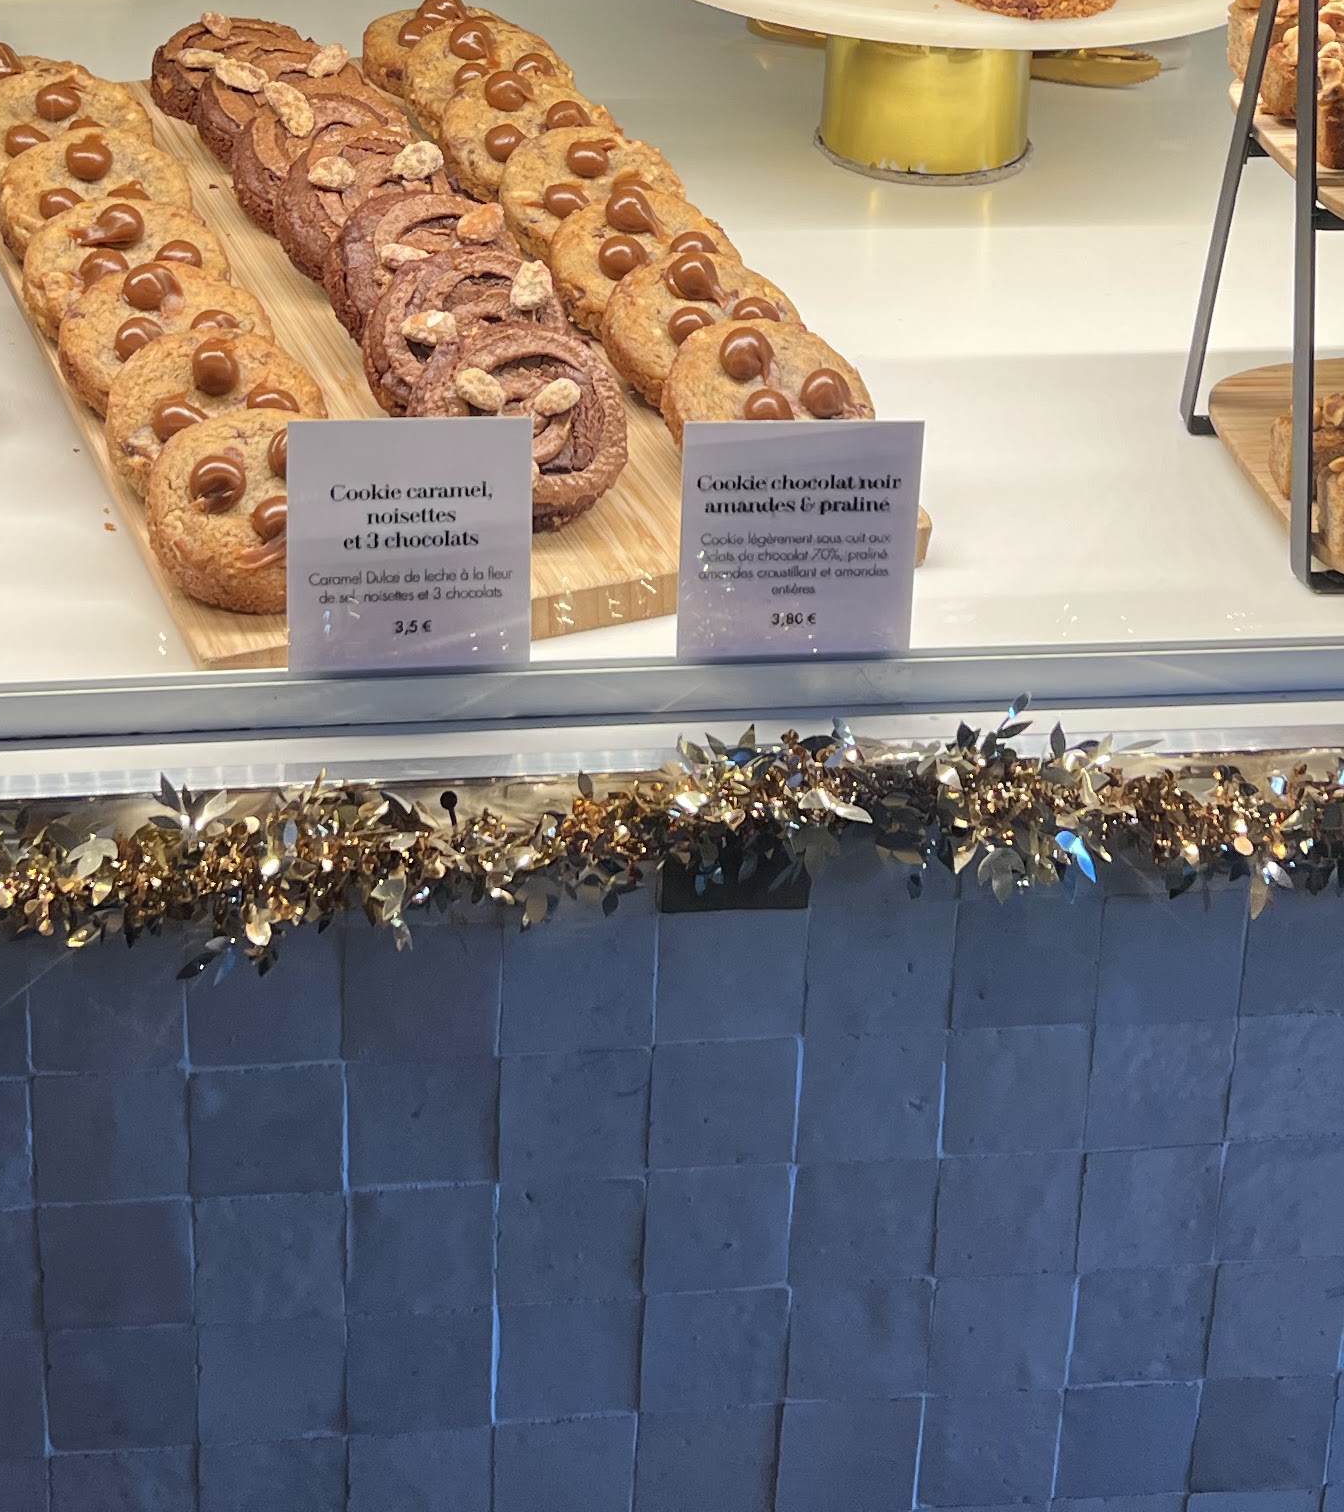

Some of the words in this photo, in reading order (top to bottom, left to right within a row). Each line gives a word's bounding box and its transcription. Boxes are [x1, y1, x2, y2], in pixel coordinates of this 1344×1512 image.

[330, 484, 401, 502] Cookie
[407, 481, 493, 500] caramel,
[697, 474, 767, 492] Cookie
[771, 474, 855, 490] chocolat
[859, 473, 902, 490] noir
[705, 496, 795, 514] amandes
[800, 496, 815, 513] &
[819, 494, 890, 516] praliné
[367, 508, 456, 526] noisettes
[344, 535, 361, 550] et
[367, 532, 379, 549] 3
[385, 530, 479, 548] chocolats
[701, 532, 744, 547] Cookie
[747, 532, 812, 548] légèrement
[816, 534, 841, 544] sous
[845, 532, 865, 544] cuit
[869, 534, 891, 543] aux
[706, 550, 735, 563] clats
[738, 549, 754, 562] de
[758, 549, 809, 562] chocolat
[847, 549, 888, 563] praliné
[309, 570, 362, 586] Caramel
[367, 569, 400, 584] Dulce
[404, 569, 421, 583] de
[425, 568, 456, 582] leche
[460, 567, 469, 581] à
[473, 566, 484, 580] la
[488, 565, 513, 580] fleur
[699, 567, 753, 580] amandes
[757, 565, 817, 579] croustillant
[820, 567, 831, 577] et
[835, 564, 888, 577] amandes
[319, 589, 335, 604] de
[364, 588, 414, 603] noisettes
[418, 588, 429, 601] et
[433, 587, 442, 600] 3
[446, 584, 502, 599] chocolats
[771, 584, 816, 595] entières
[395, 620, 418, 635] 3,5
[422, 620, 432, 633] €
[808, 612, 816, 625] €
